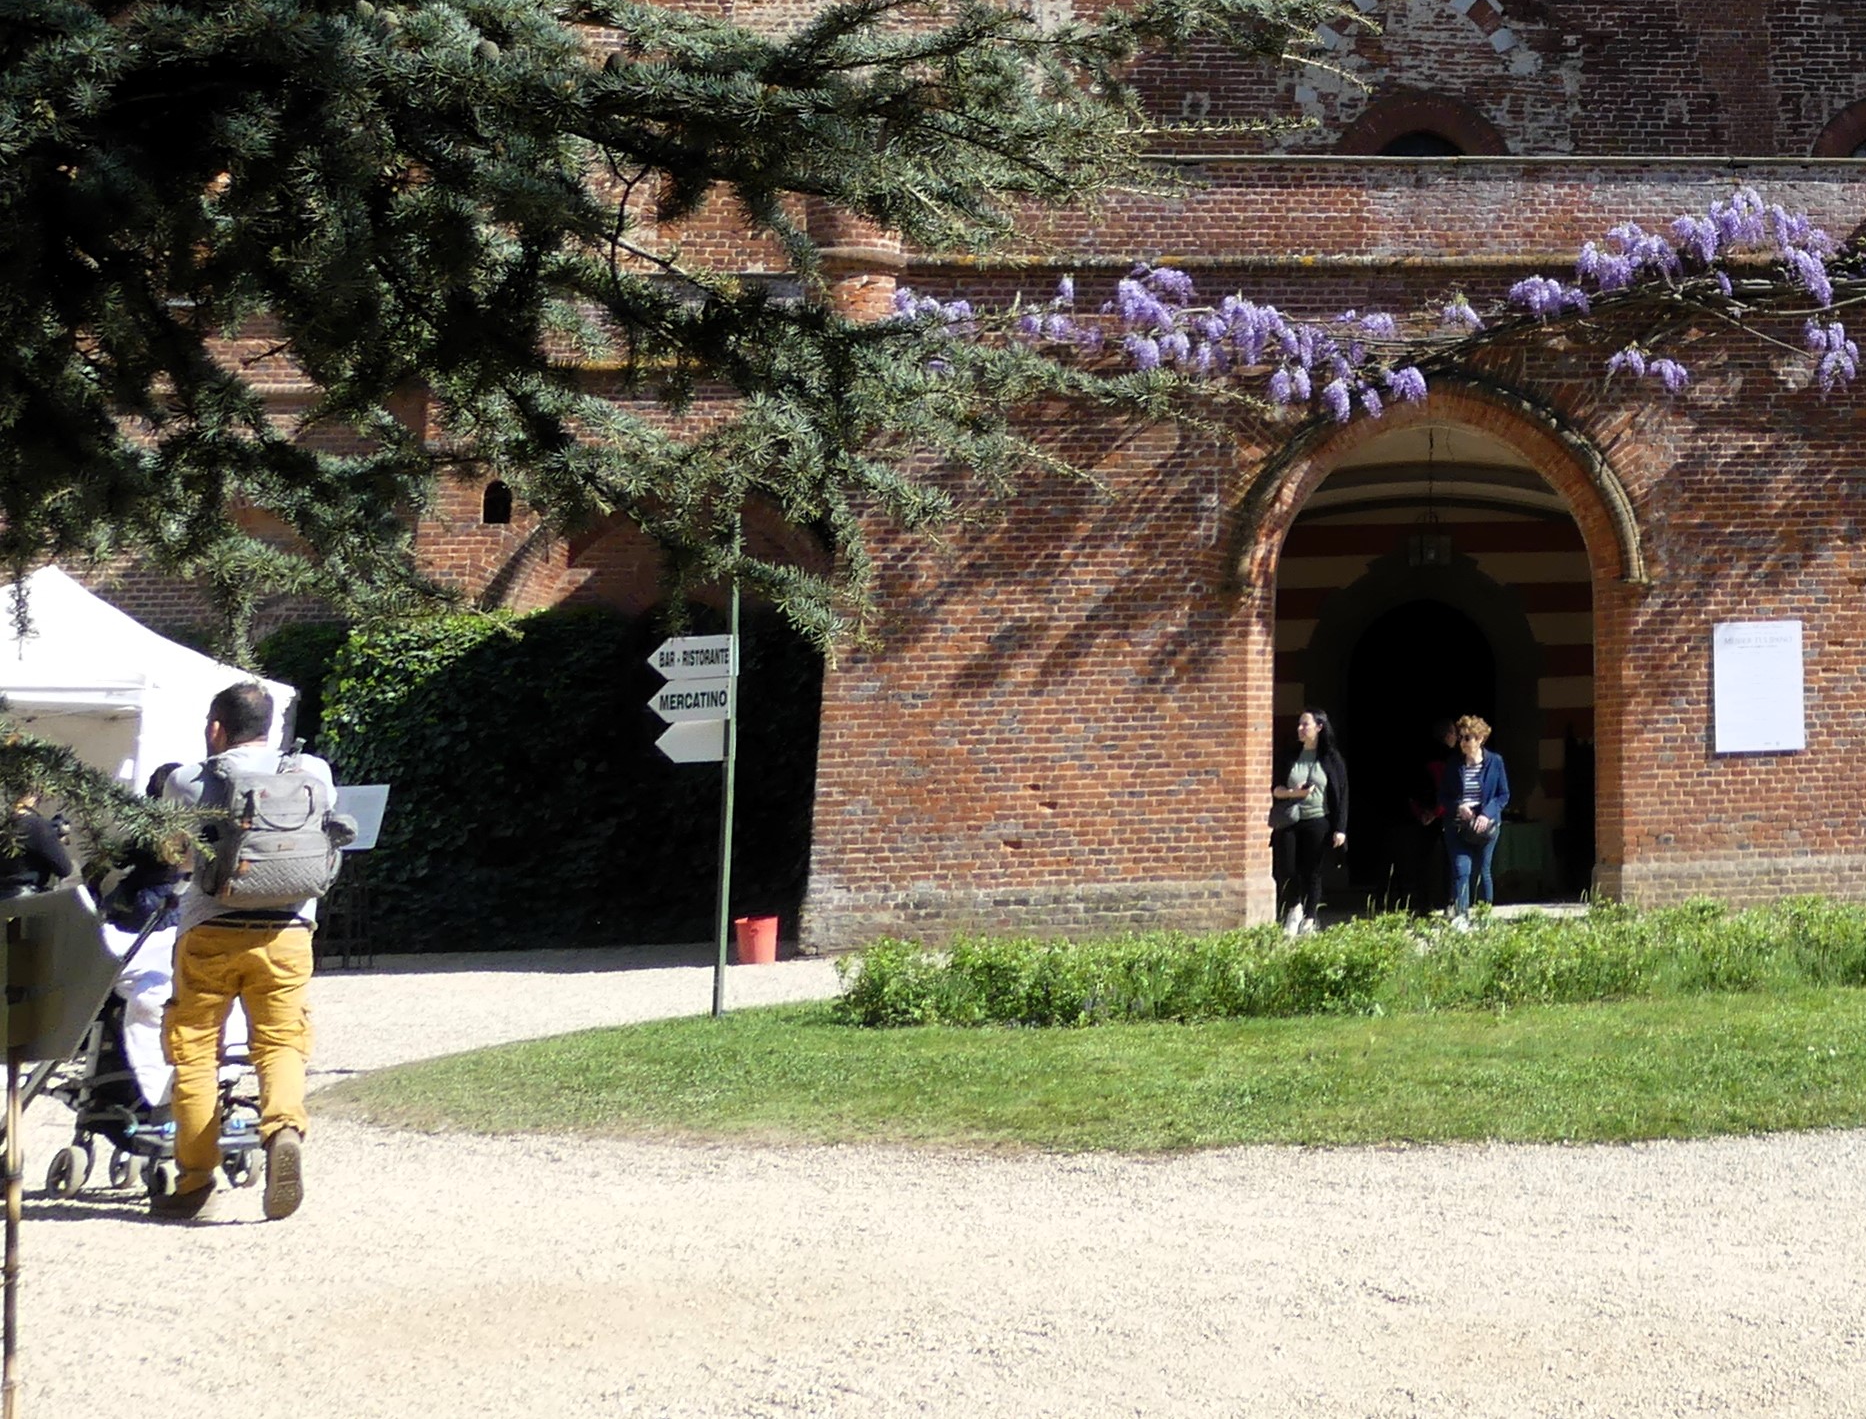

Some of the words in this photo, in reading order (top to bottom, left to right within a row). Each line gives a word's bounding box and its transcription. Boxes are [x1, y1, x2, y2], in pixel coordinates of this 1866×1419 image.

[659, 651, 675, 668] BAR
[682, 647, 730, 667] RISTORANTE
[659, 689, 728, 711] MERCATINO
